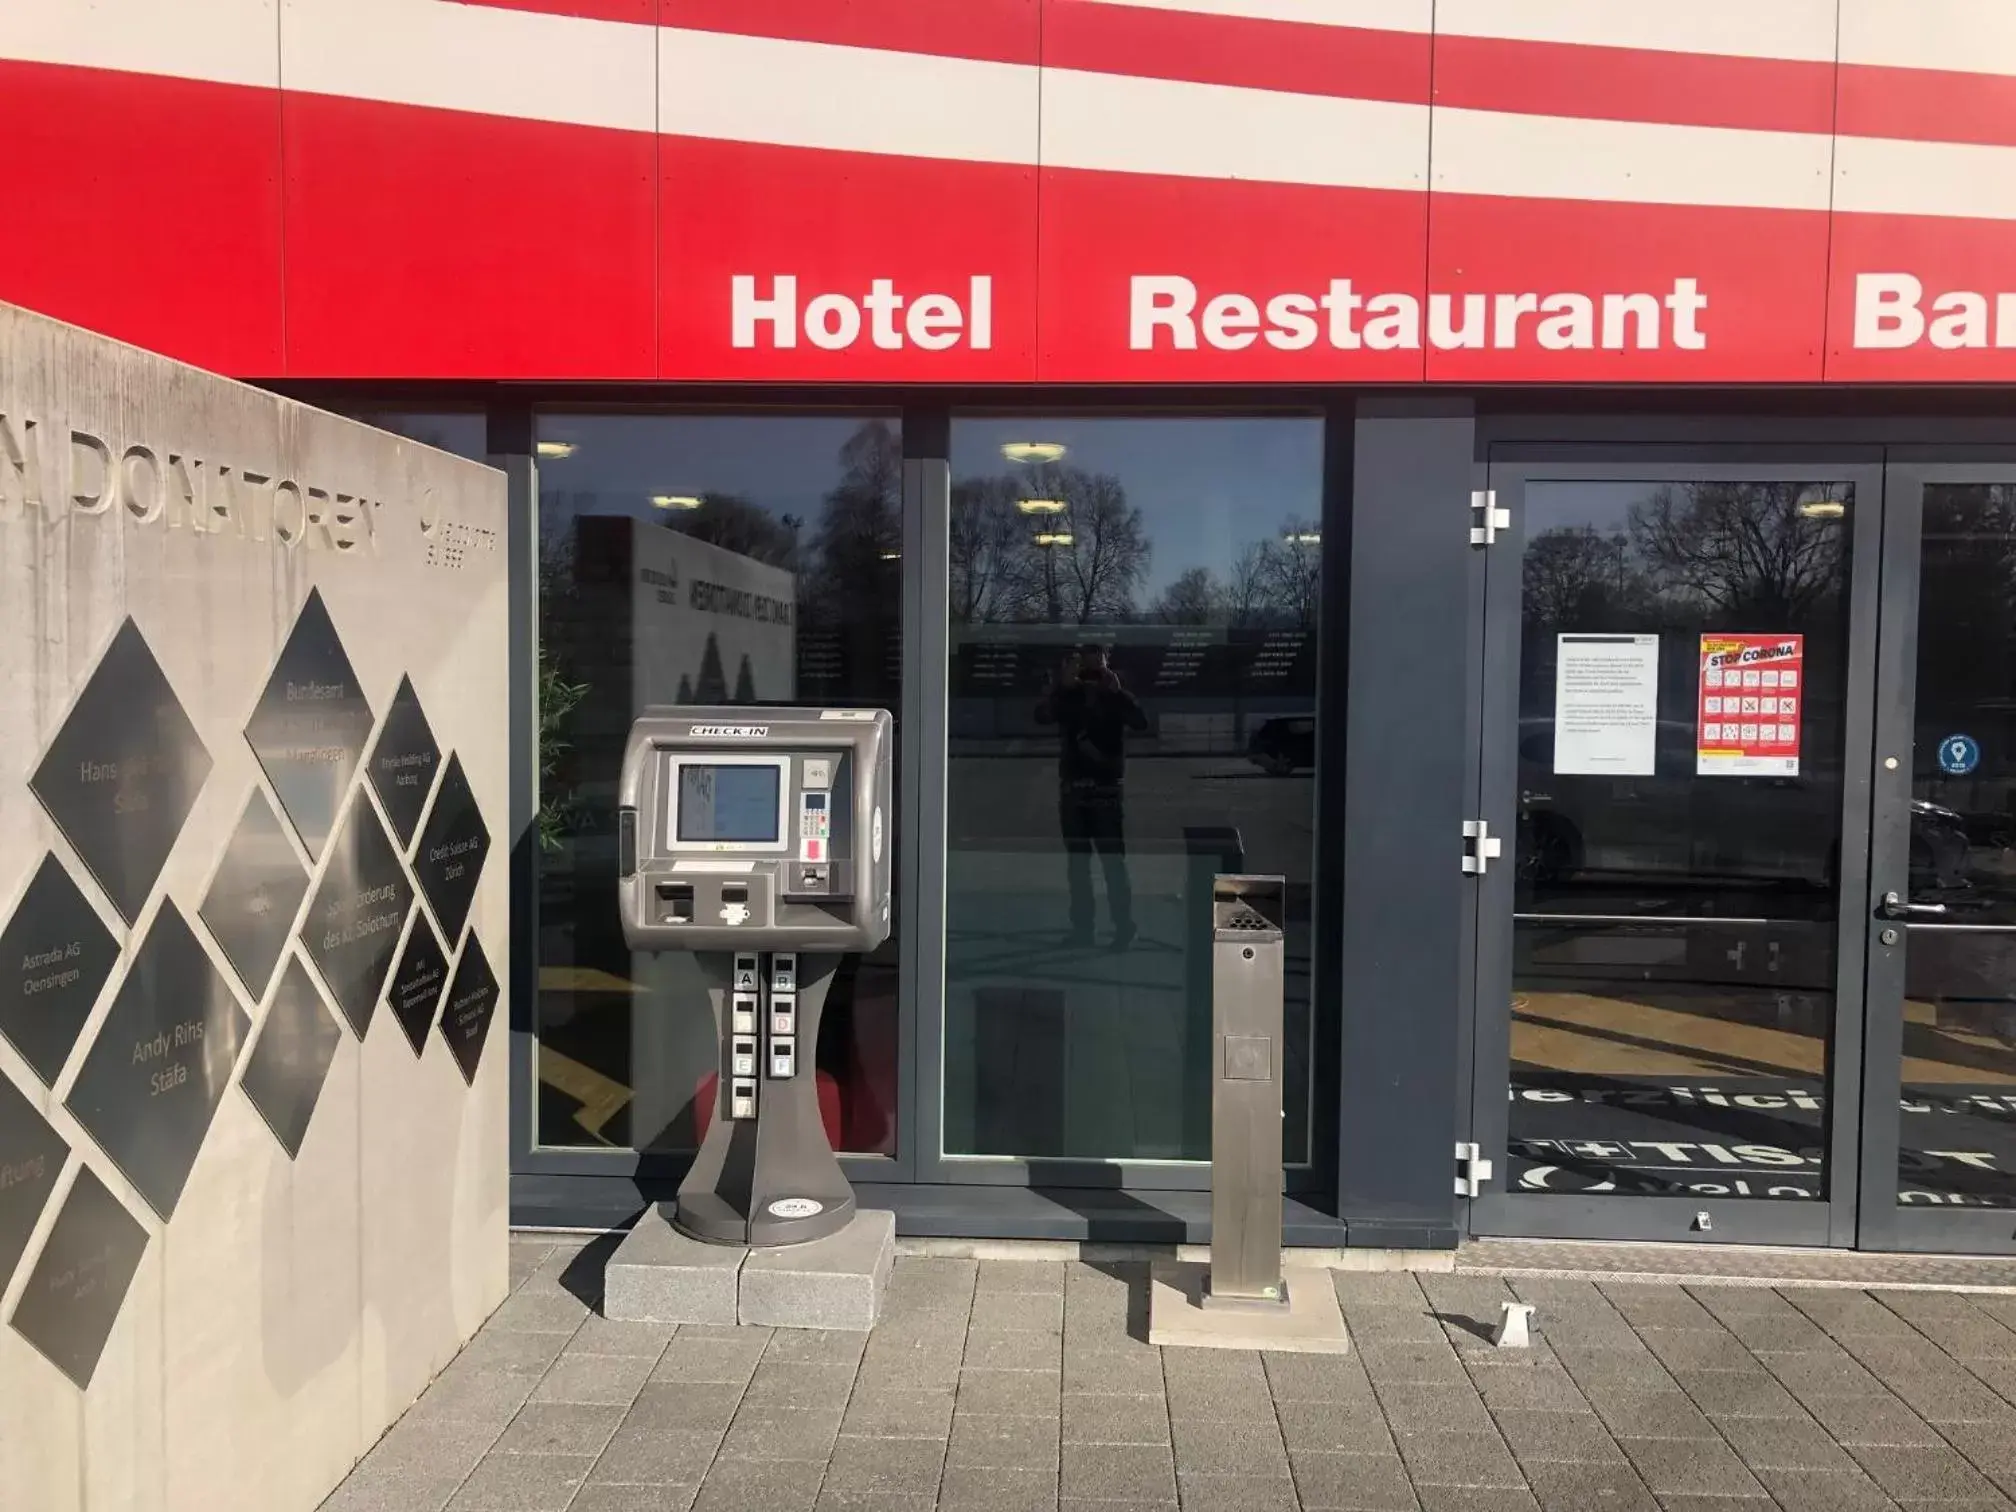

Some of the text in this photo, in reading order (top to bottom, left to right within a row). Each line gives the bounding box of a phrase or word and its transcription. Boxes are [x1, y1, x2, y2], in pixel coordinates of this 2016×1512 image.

[733, 275, 992, 350] Hotel
[1130, 276, 1708, 350] Restaurant
[1711, 652, 1741, 666] STOP
[1742, 645, 1794, 662] CORONA
[691, 727, 766, 735] CHECK-IN
[80, 760, 117, 784] Hans
[21, 941, 81, 971] Astrada AG
[23, 967, 80, 996] Oensingen
[741, 972, 752, 984] A
[132, 1020, 203, 1066] Andy Rihs
